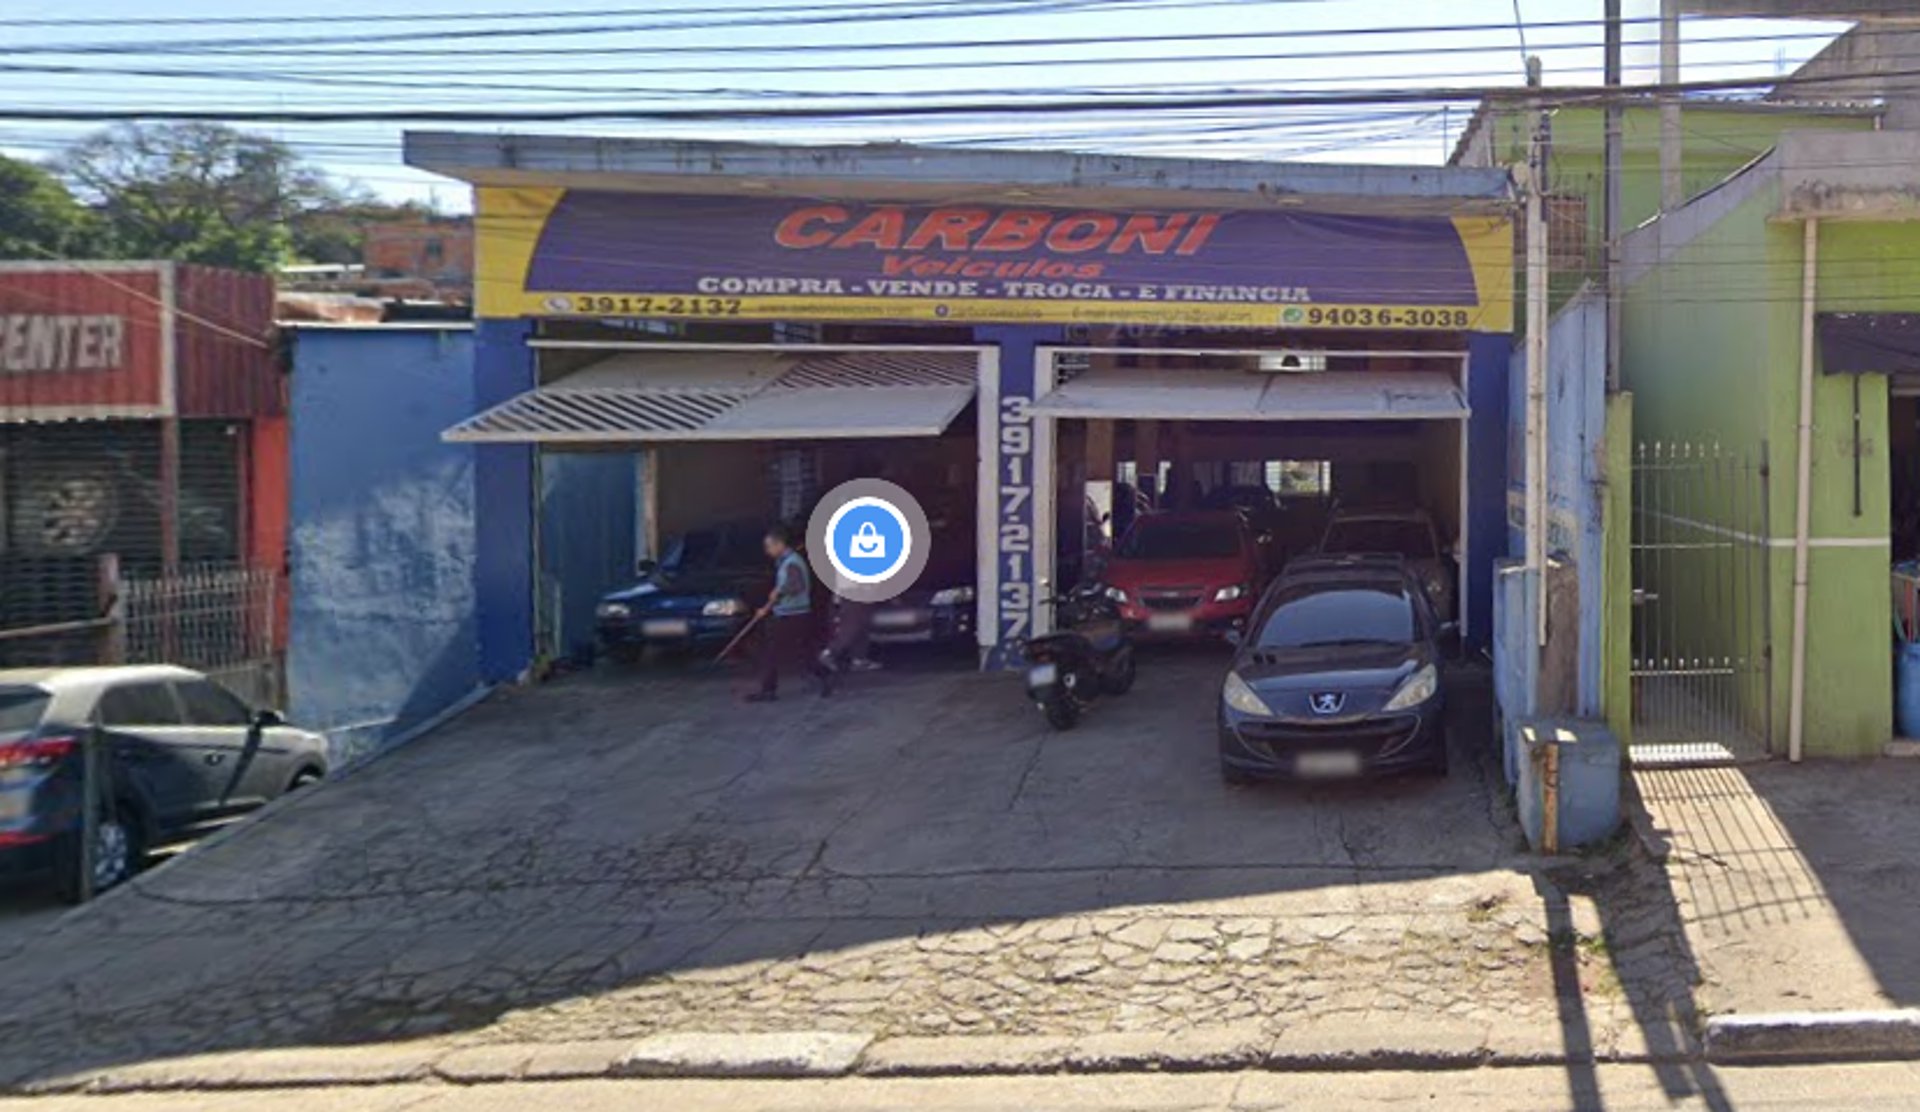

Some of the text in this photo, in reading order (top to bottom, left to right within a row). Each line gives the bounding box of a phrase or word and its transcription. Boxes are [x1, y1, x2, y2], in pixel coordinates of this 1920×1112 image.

[774, 205, 1221, 256] CARBONI
[698, 277, 844, 295] COMPRA
[867, 279, 978, 297] VENDE
[1003, 281, 1112, 299] TROCA
[1139, 284, 1157, 299] E
[1164, 285, 1311, 302] FINANCIA
[1308, 307, 1468, 327] 94036-3038
[0, 314, 122, 370] ENTER
